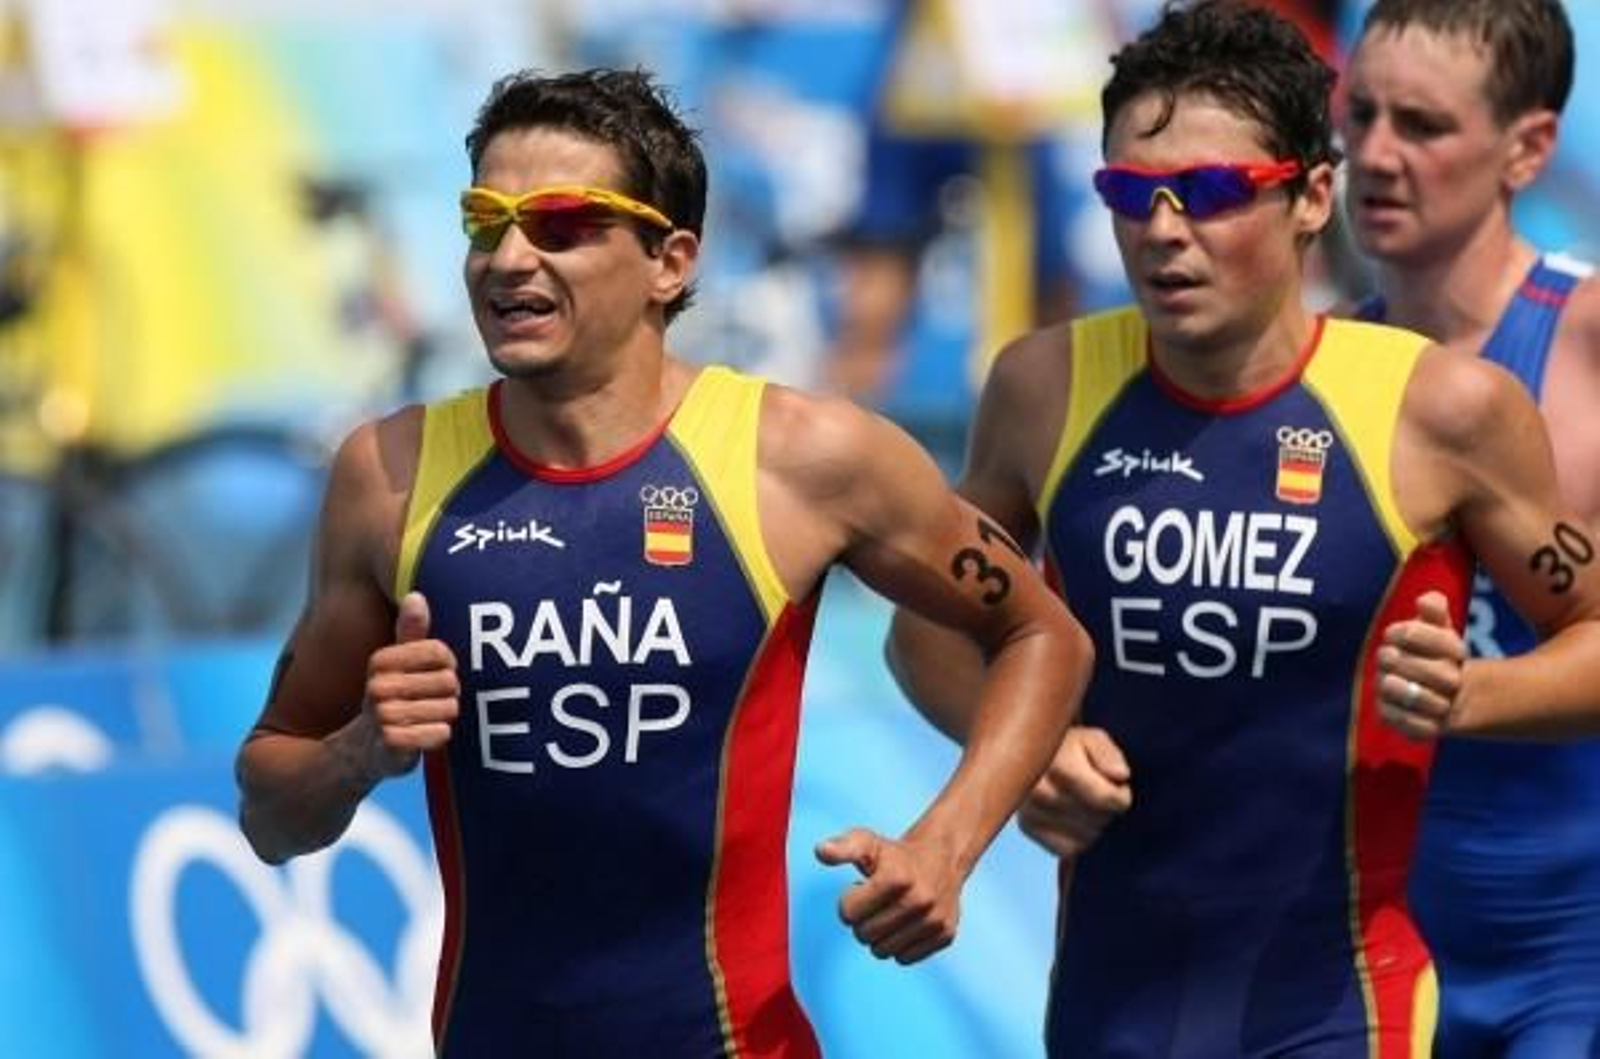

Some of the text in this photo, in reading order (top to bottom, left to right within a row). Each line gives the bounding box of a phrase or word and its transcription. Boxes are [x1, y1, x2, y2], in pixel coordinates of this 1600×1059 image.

[1095, 449, 1204, 481] Spiuk
[448, 519, 566, 554] Spiuk
[951, 516, 1026, 605] 31
[1104, 505, 1318, 595] GOMEZ
[1529, 521, 1594, 594] 30
[469, 580, 693, 671] RAÑA
[1111, 597, 1318, 679] ESP
[475, 682, 692, 774] ESP
